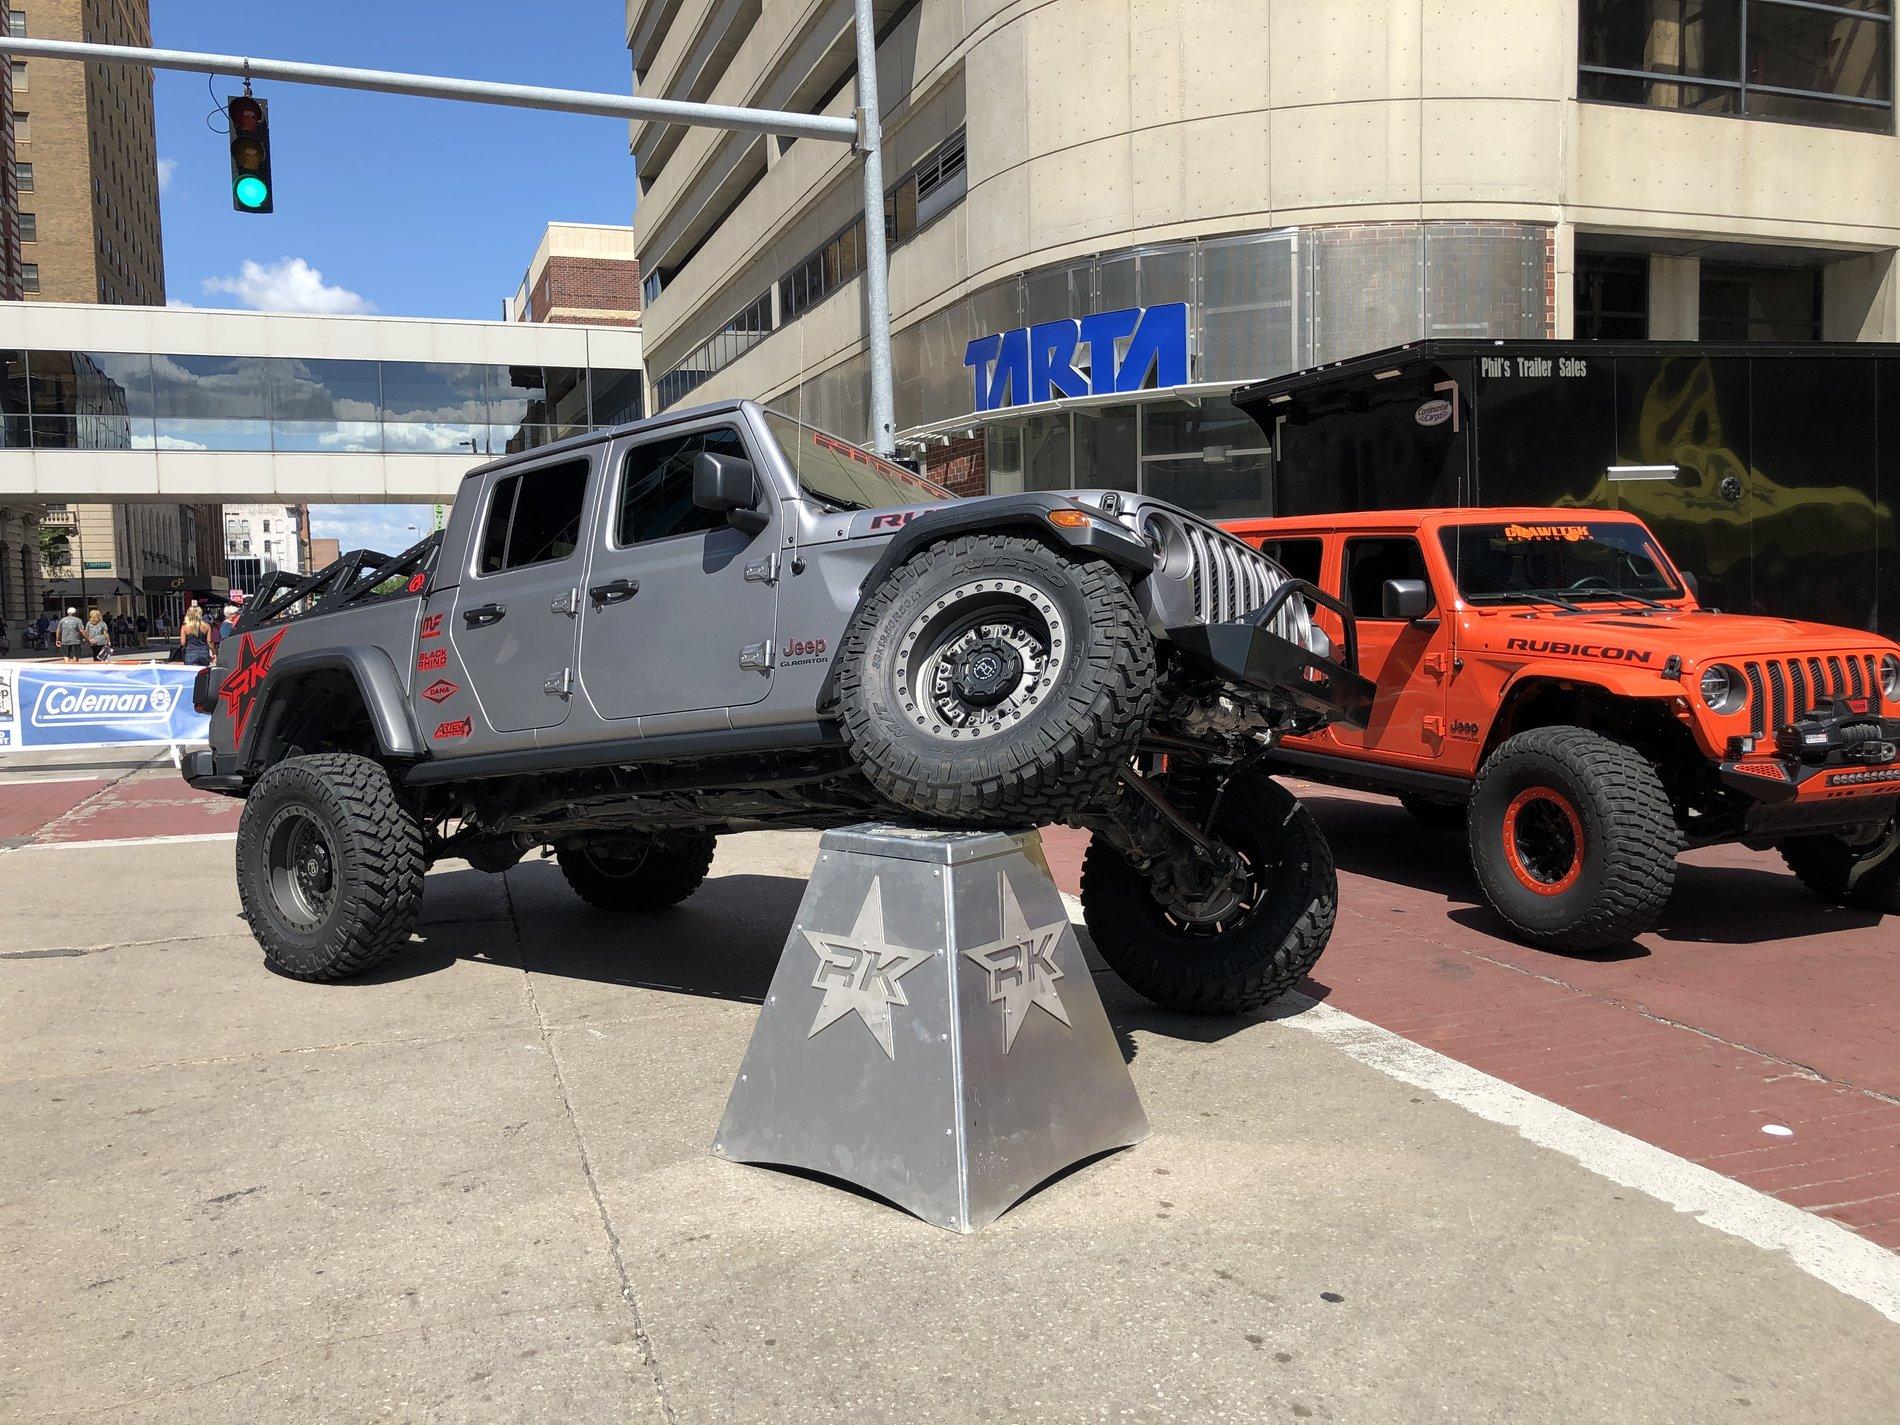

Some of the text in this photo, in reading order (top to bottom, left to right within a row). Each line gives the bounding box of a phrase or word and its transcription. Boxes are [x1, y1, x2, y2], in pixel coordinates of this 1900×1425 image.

[964, 302, 1189, 412] TARTA
[1481, 357, 1587, 377] Phil's Trailer Sales
[419, 648, 447, 661] BLACK
[783, 638, 827, 657] Jeep
[1507, 638, 1652, 663] RUBICON
[418, 656, 447, 668] RHINO
[780, 657, 828, 667] GLADIATOR
[45, 687, 150, 714] Coleman
[430, 687, 449, 695] DANA
